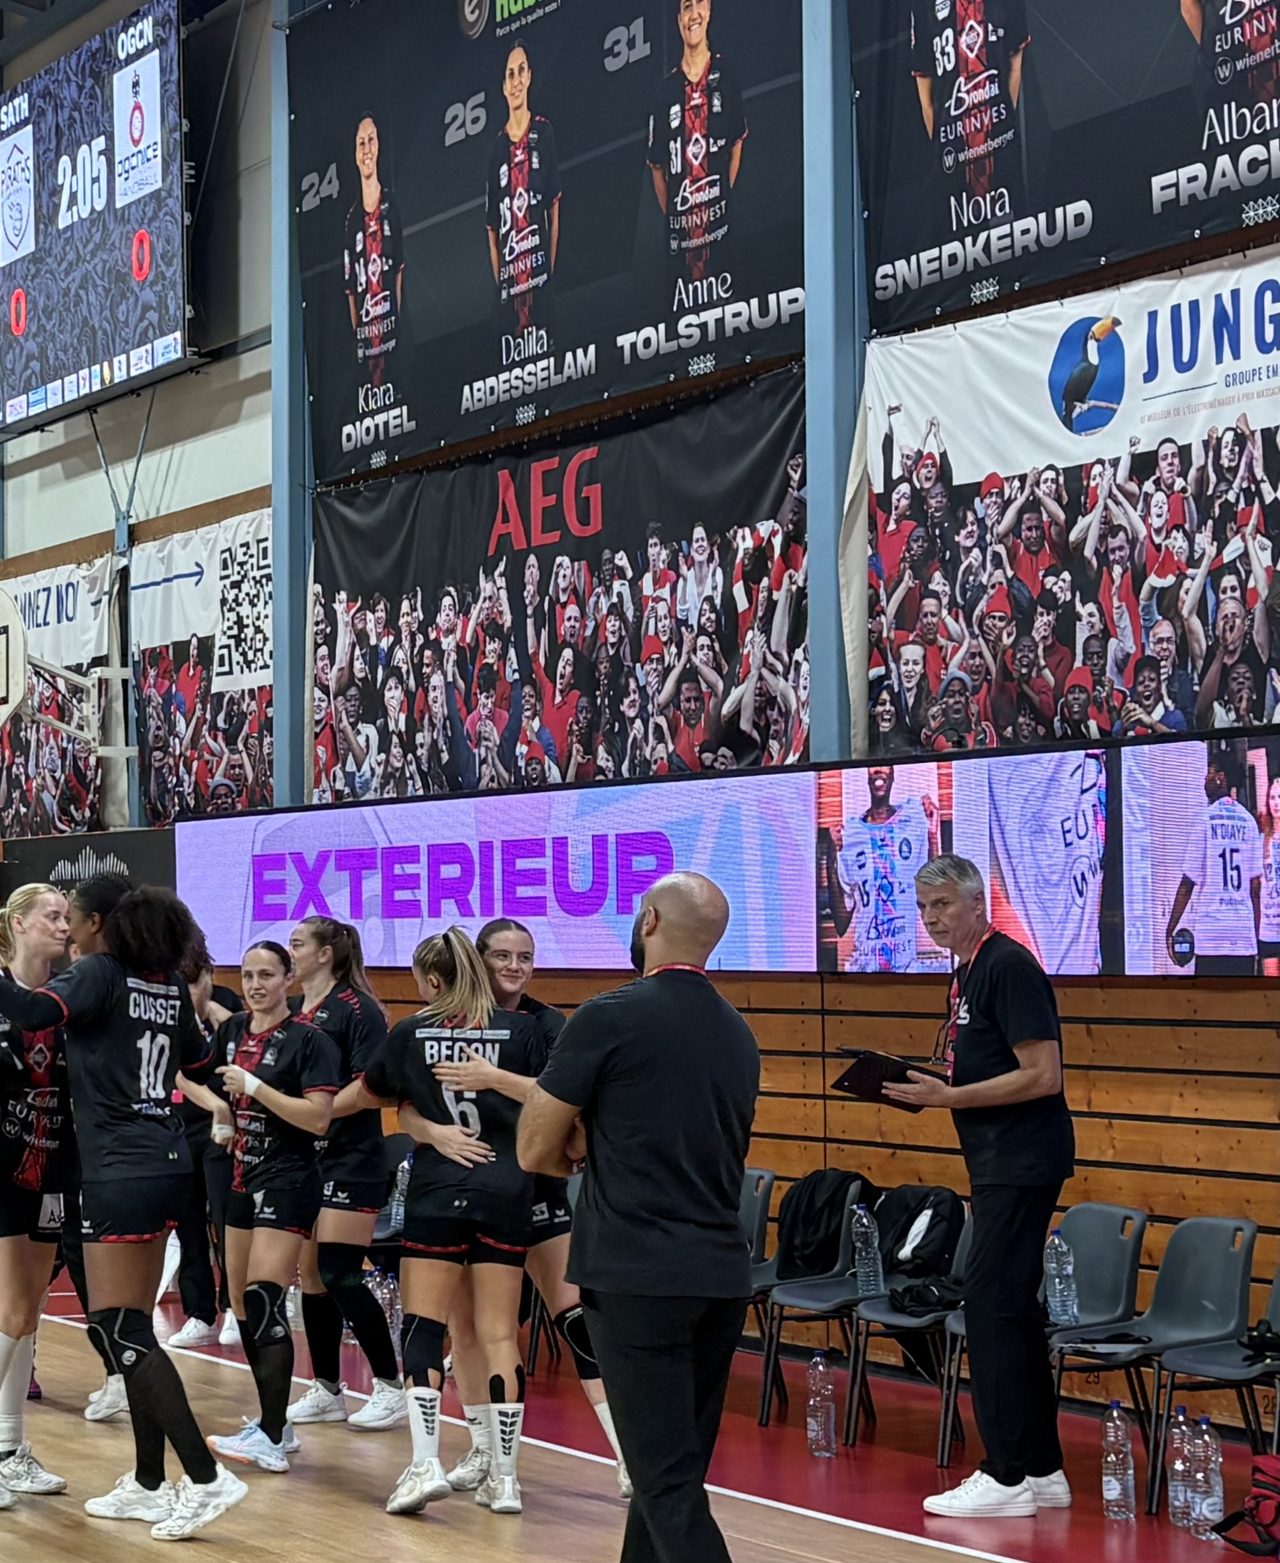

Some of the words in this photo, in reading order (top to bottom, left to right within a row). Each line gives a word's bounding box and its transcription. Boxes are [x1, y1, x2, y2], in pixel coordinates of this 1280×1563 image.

[117, 16, 153, 60] OGCN
[603, 16, 651, 73] 31
[0, 93, 29, 131] SATH
[444, 91, 487, 147] 26
[57, 134, 108, 230] 2:05
[301, 163, 340, 212] 24
[670, 200, 727, 229] EURINVEST
[950, 187, 1010, 231] Nora
[132, 229, 151, 282] 0
[874, 199, 1093, 300] SNEDKERUD
[11, 288, 27, 337] 0
[672, 269, 733, 312] Anne
[501, 325, 549, 366] Dalila
[616, 286, 806, 365] TOLSTRUP
[358, 379, 396, 415] Kiara
[460, 343, 597, 416] ABDESSELAM
[1224, 366, 1262, 388] GROUPE
[341, 404, 416, 453] DIOTEL
[488, 445, 603, 557] AEG
[252, 830, 675, 922] EXTERIEUR
[1218, 847, 1242, 892] 15
[129, 992, 181, 1025] CUSSET
[136, 1030, 171, 1099] 10
[424, 1041, 500, 1068] BEGON
